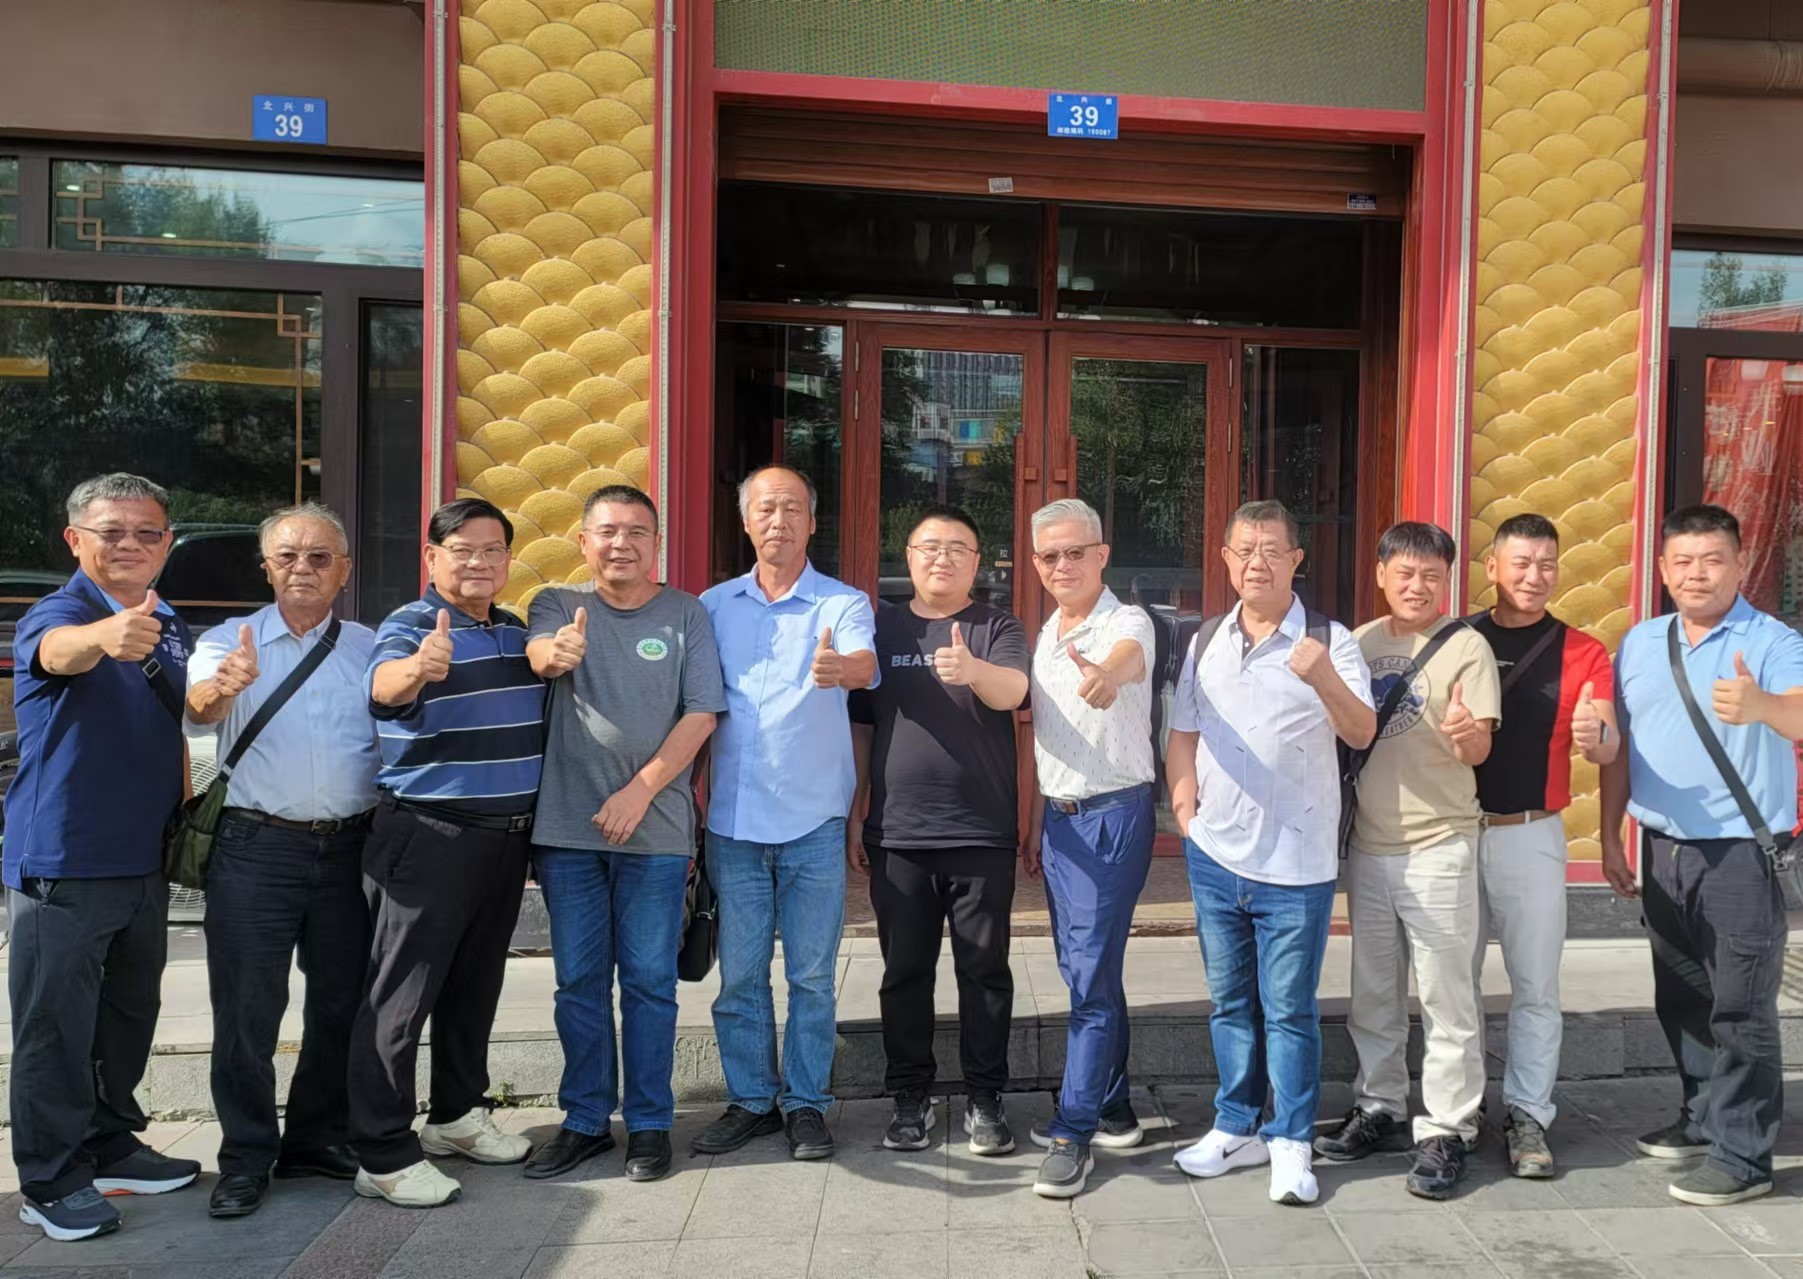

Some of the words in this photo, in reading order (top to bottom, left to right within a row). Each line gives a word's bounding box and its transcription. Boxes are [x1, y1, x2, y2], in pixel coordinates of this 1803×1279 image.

[262, 100, 315, 113] 北兴街
[1069, 105, 1099, 127] 39
[274, 114, 303, 138] 39
[891, 653, 934, 667] BEAS
